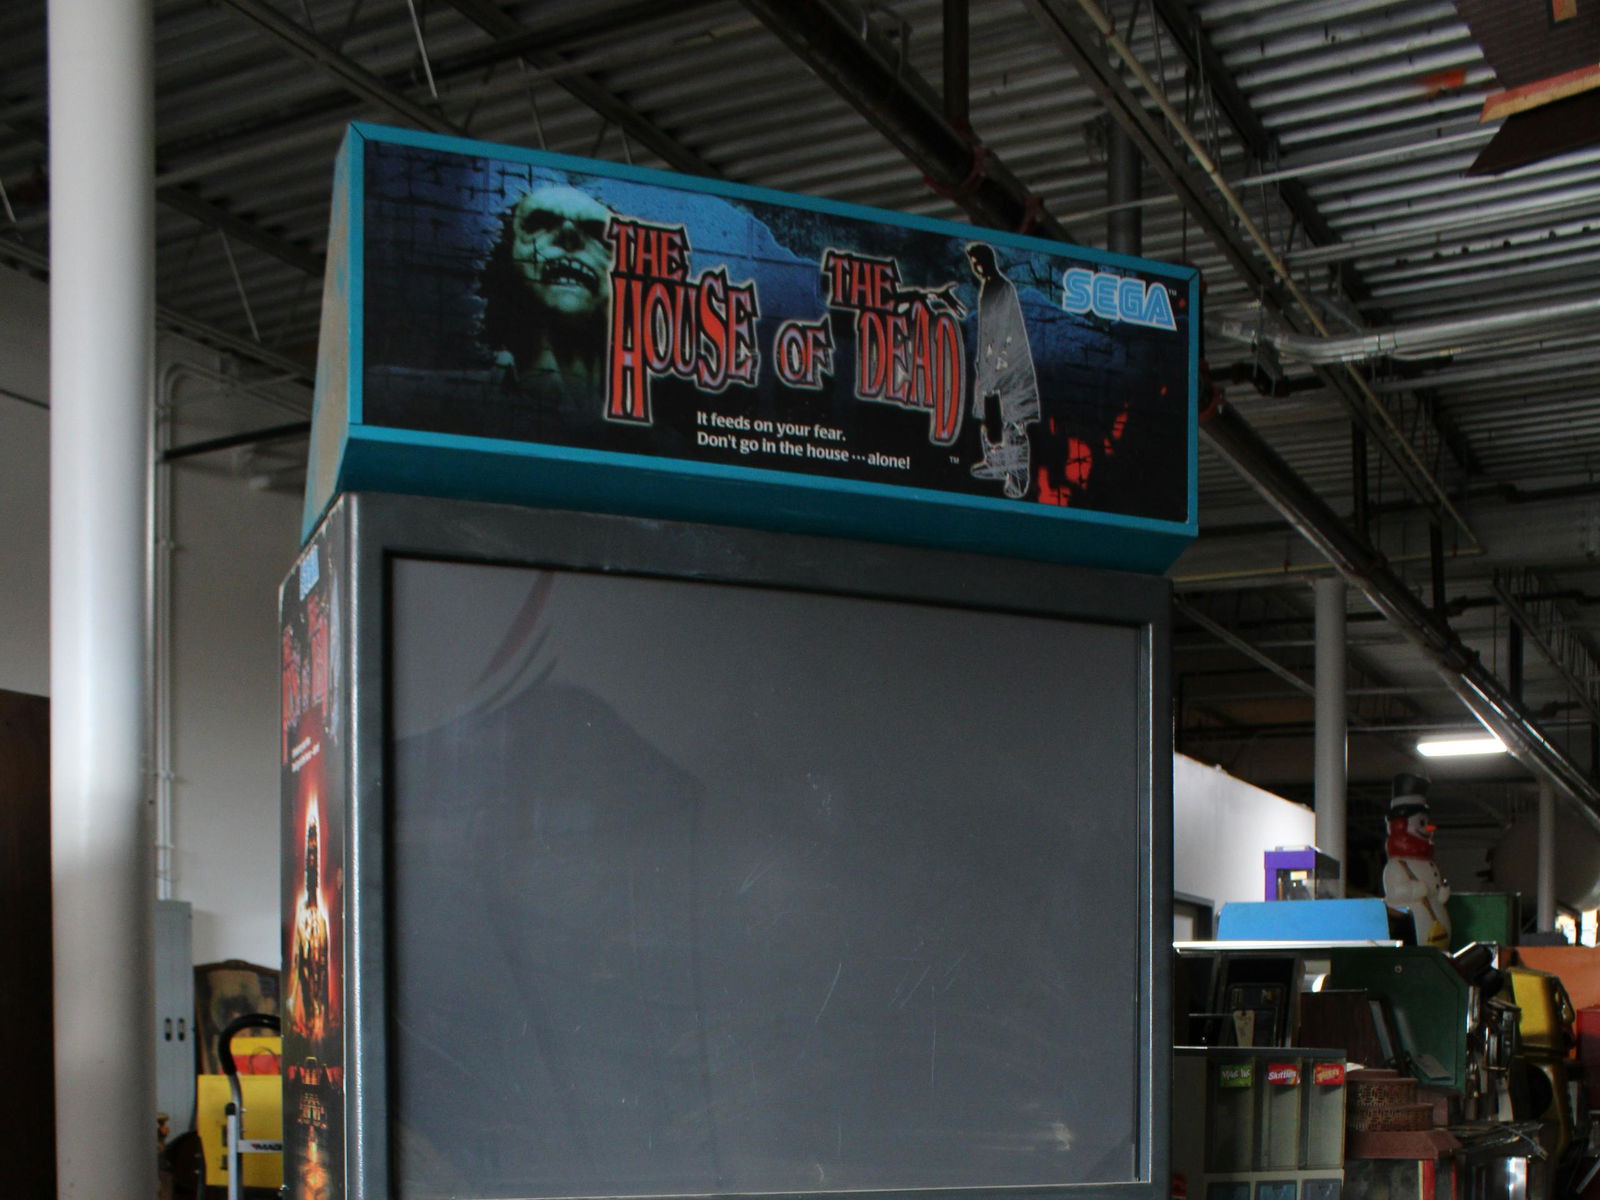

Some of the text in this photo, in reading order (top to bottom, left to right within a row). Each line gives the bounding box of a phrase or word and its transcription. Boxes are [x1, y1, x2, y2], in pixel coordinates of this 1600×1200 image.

[606, 213, 691, 282] THE
[821, 247, 903, 311] THE
[1062, 267, 1178, 331] SEGA
[604, 264, 835, 425] HOUSE OF
[854, 299, 966, 446] DEAD
[697, 411, 847, 441] It feeds on your fear.
[697, 431, 738, 450] Don't
[740, 437, 759, 454] go
[762, 438, 776, 453] in
[779, 440, 804, 456] the
[806, 443, 849, 462] house
